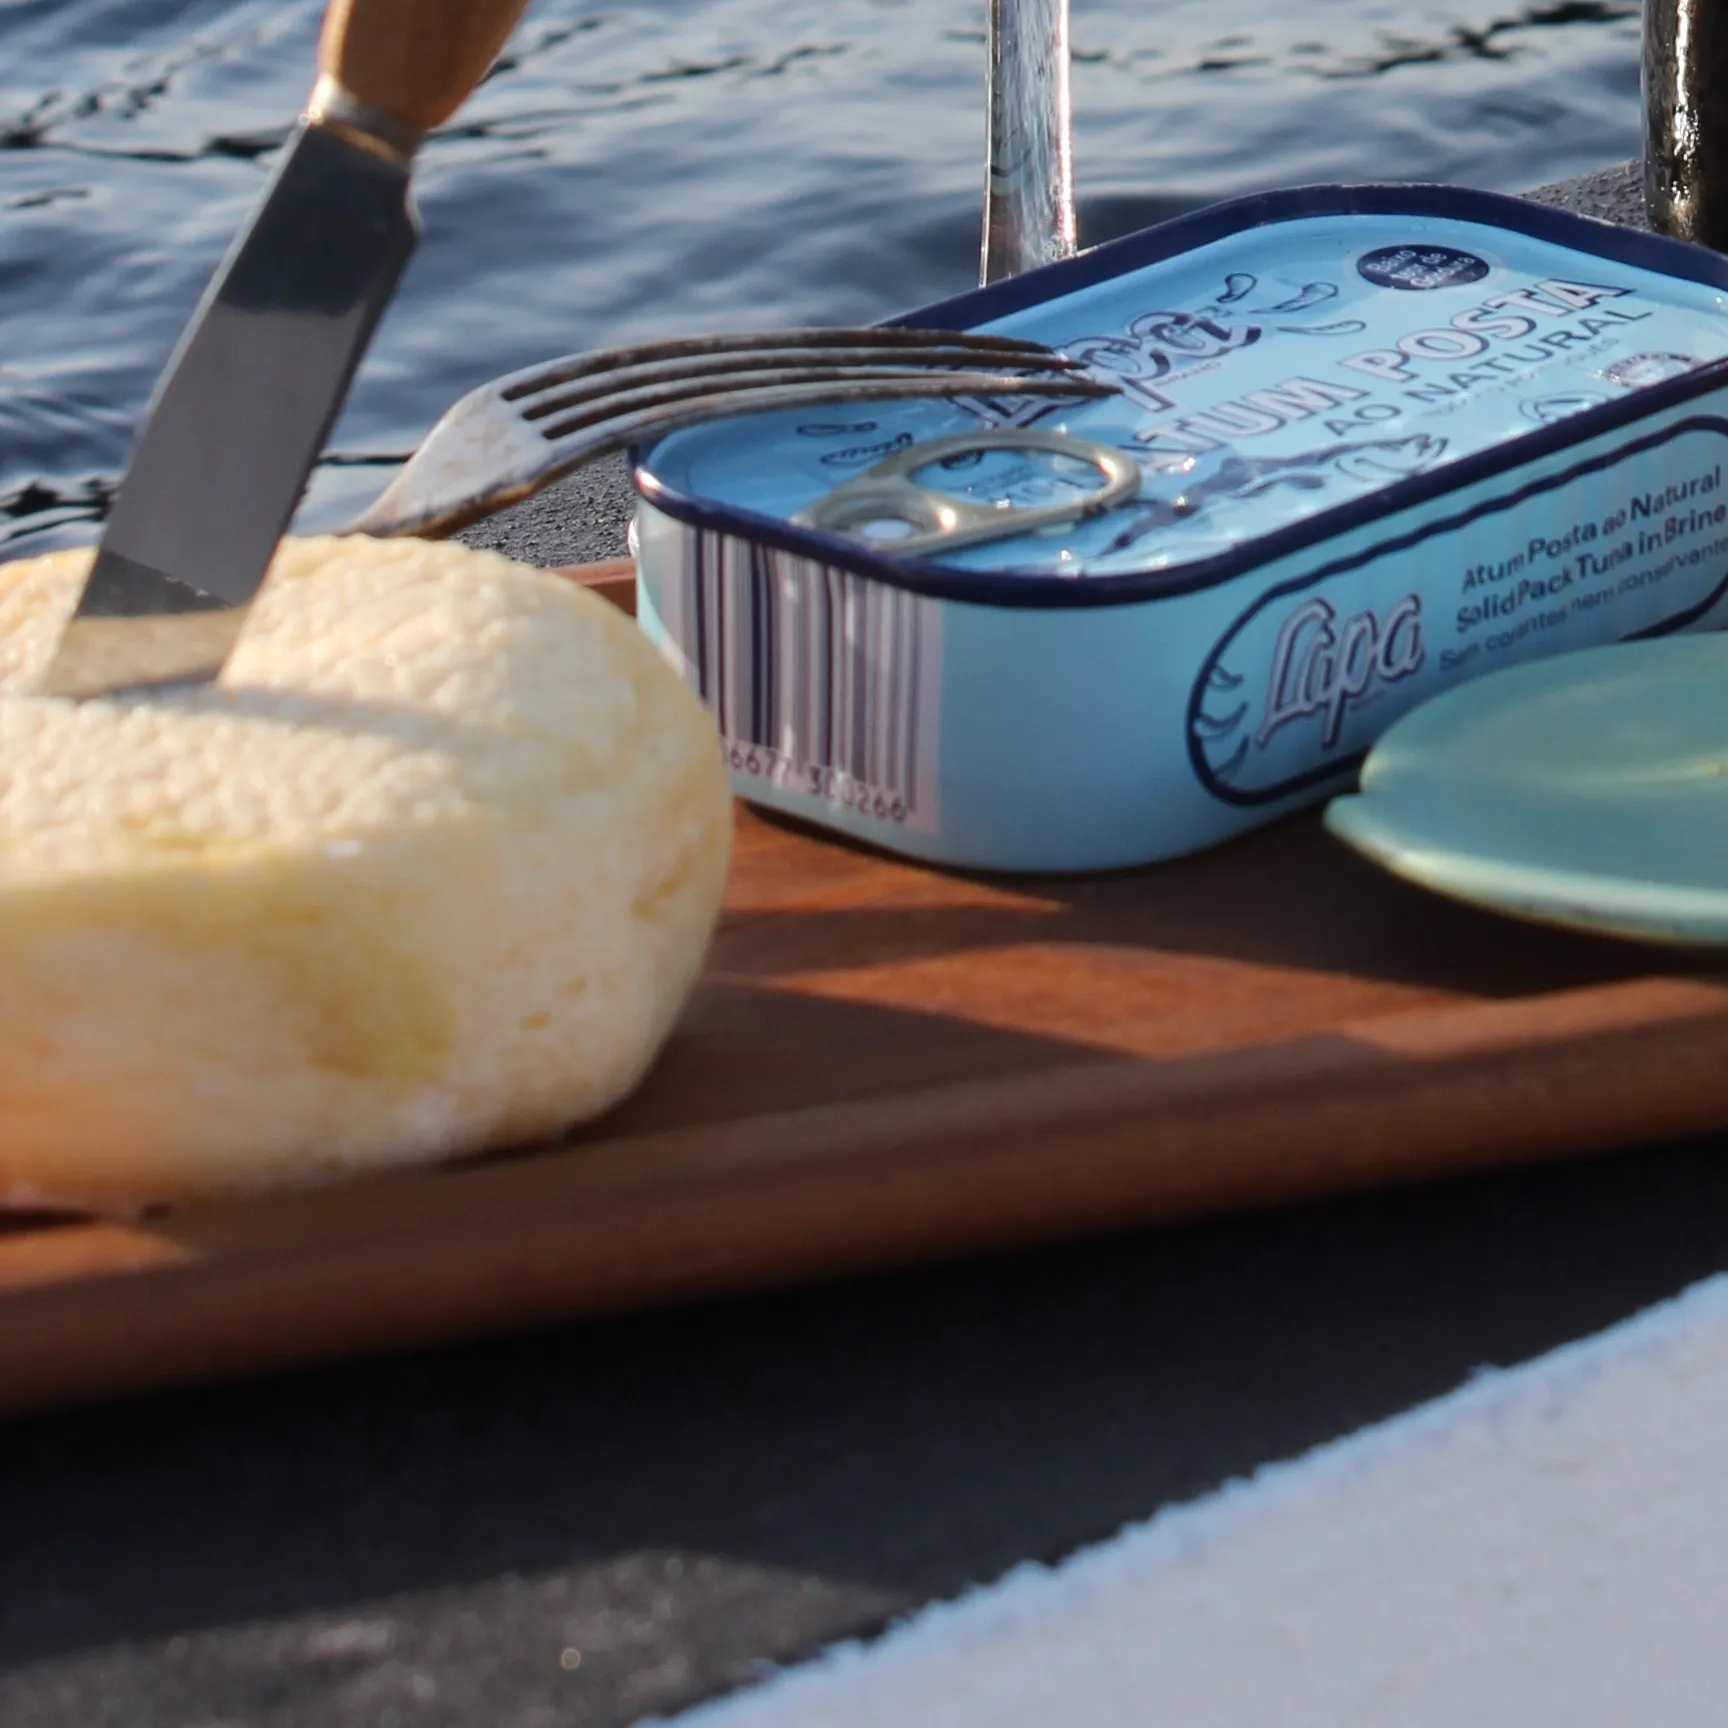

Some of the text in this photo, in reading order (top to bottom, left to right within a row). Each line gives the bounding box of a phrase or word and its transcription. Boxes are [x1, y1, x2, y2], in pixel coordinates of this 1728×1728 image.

[1324, 402, 1403, 438] AO
[1401, 309, 1654, 404] NATURAL
[1337, 278, 1637, 384] POSTA
[1516, 565, 1573, 602] Pack
[1575, 543, 1634, 580] Tuna
[1638, 530, 1663, 555] in
[1663, 503, 1728, 543] Brine
[1527, 520, 1598, 564] Posta
[1602, 509, 1628, 536] ao
[1630, 464, 1722, 522] Natural
